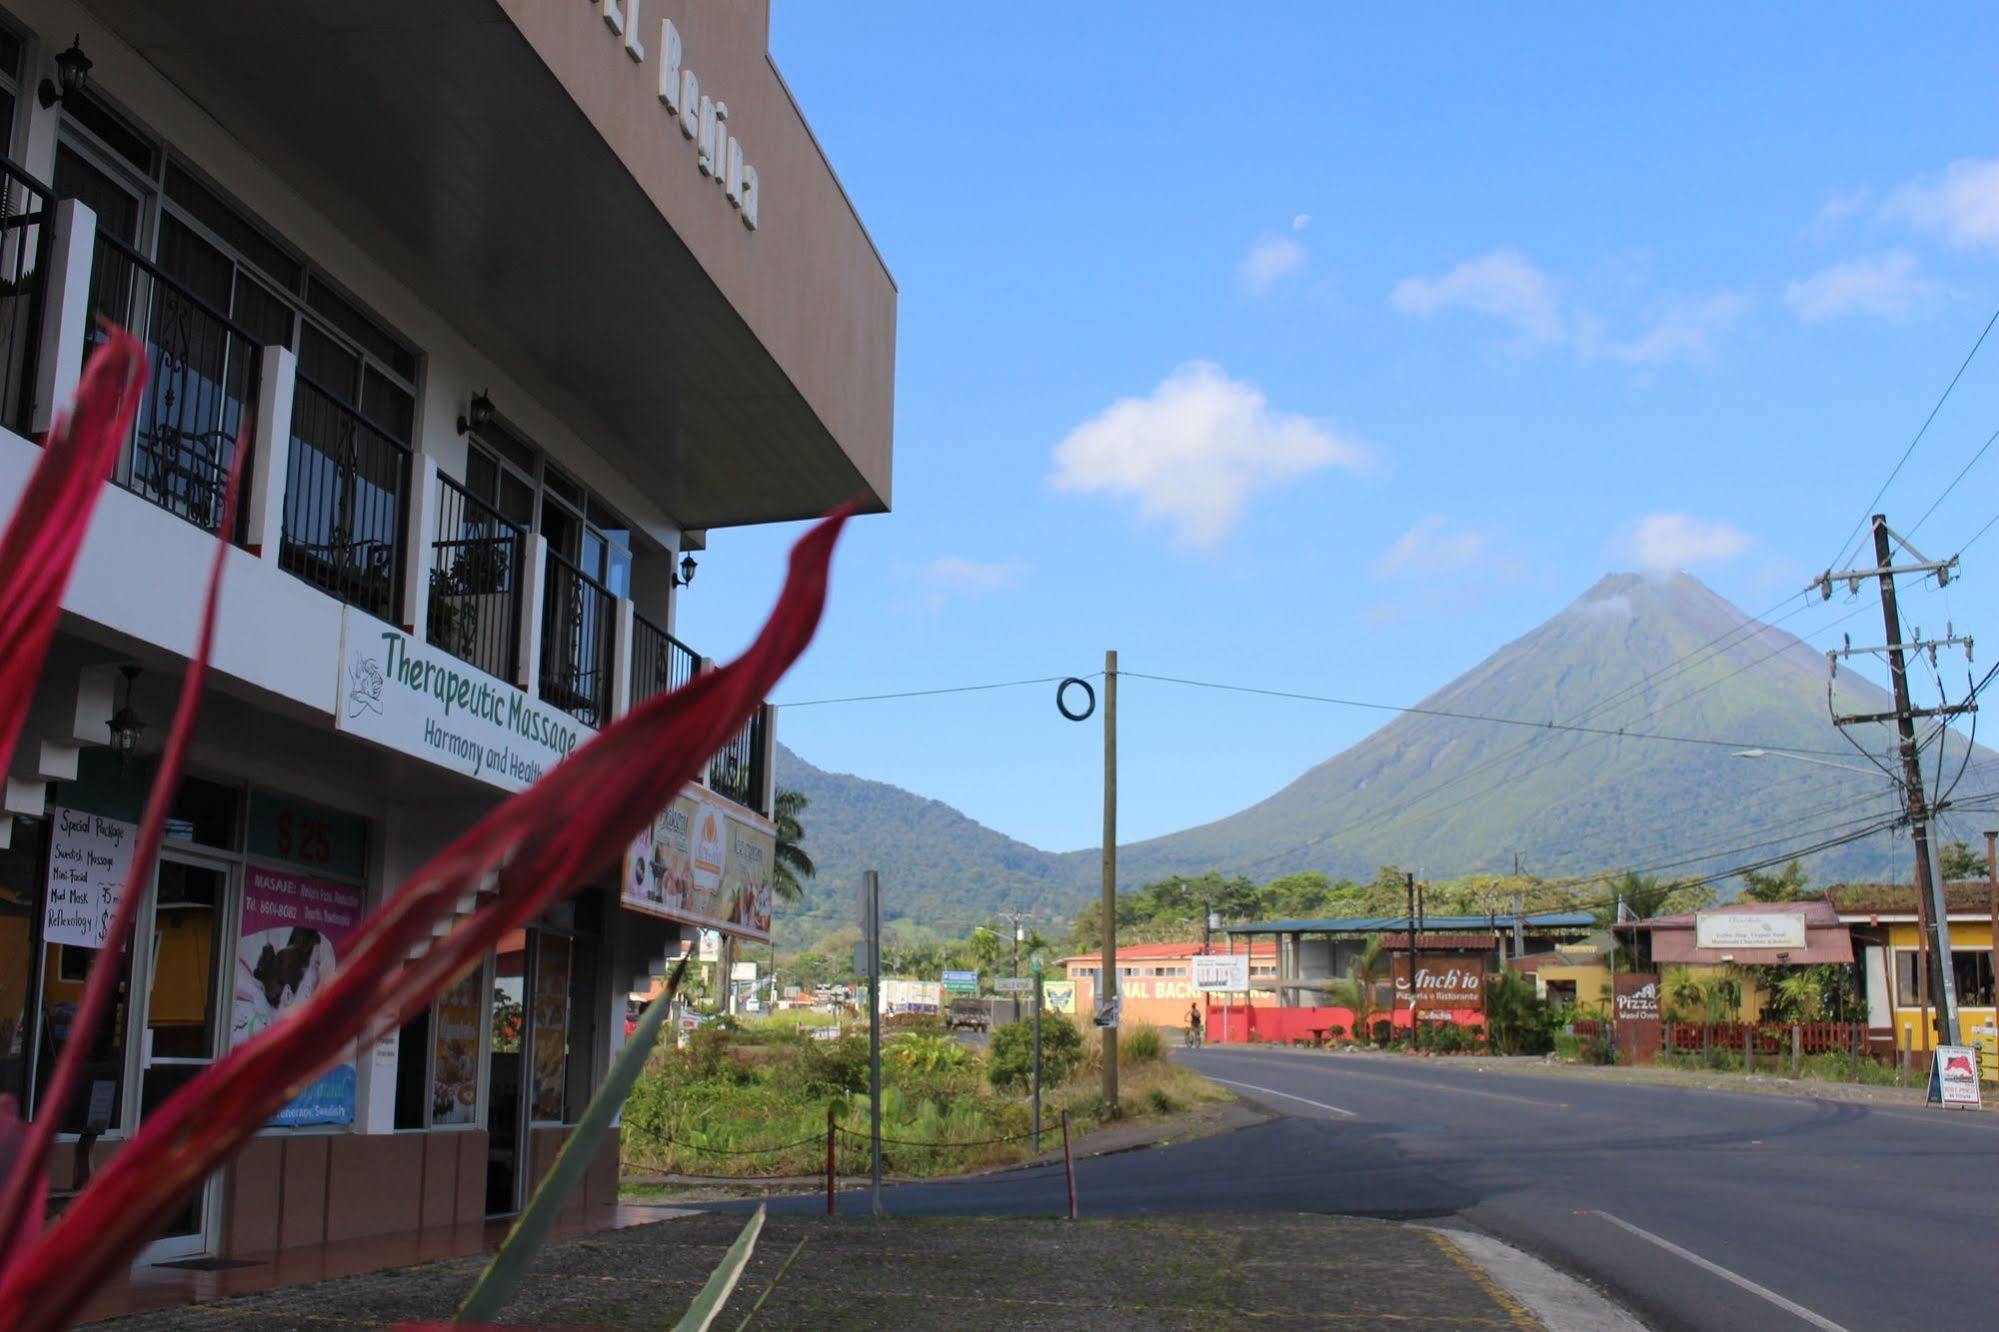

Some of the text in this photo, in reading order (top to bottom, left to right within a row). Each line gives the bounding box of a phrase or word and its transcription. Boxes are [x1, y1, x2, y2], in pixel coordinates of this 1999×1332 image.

[658, 18, 759, 231] Regina
[381, 632, 577, 763] Therapeutic Massage
[424, 718, 483, 776] Harmony
[486, 746, 508, 774] and
[61, 809, 125, 848] Special Package
[55, 843, 114, 872] Swedish Massage
[51, 888, 89, 905] Mud Mask
[48, 908, 92, 935] Reflexology
[1436, 991, 1479, 1000] Ristorante
[1616, 994, 1658, 1010] Pizza
